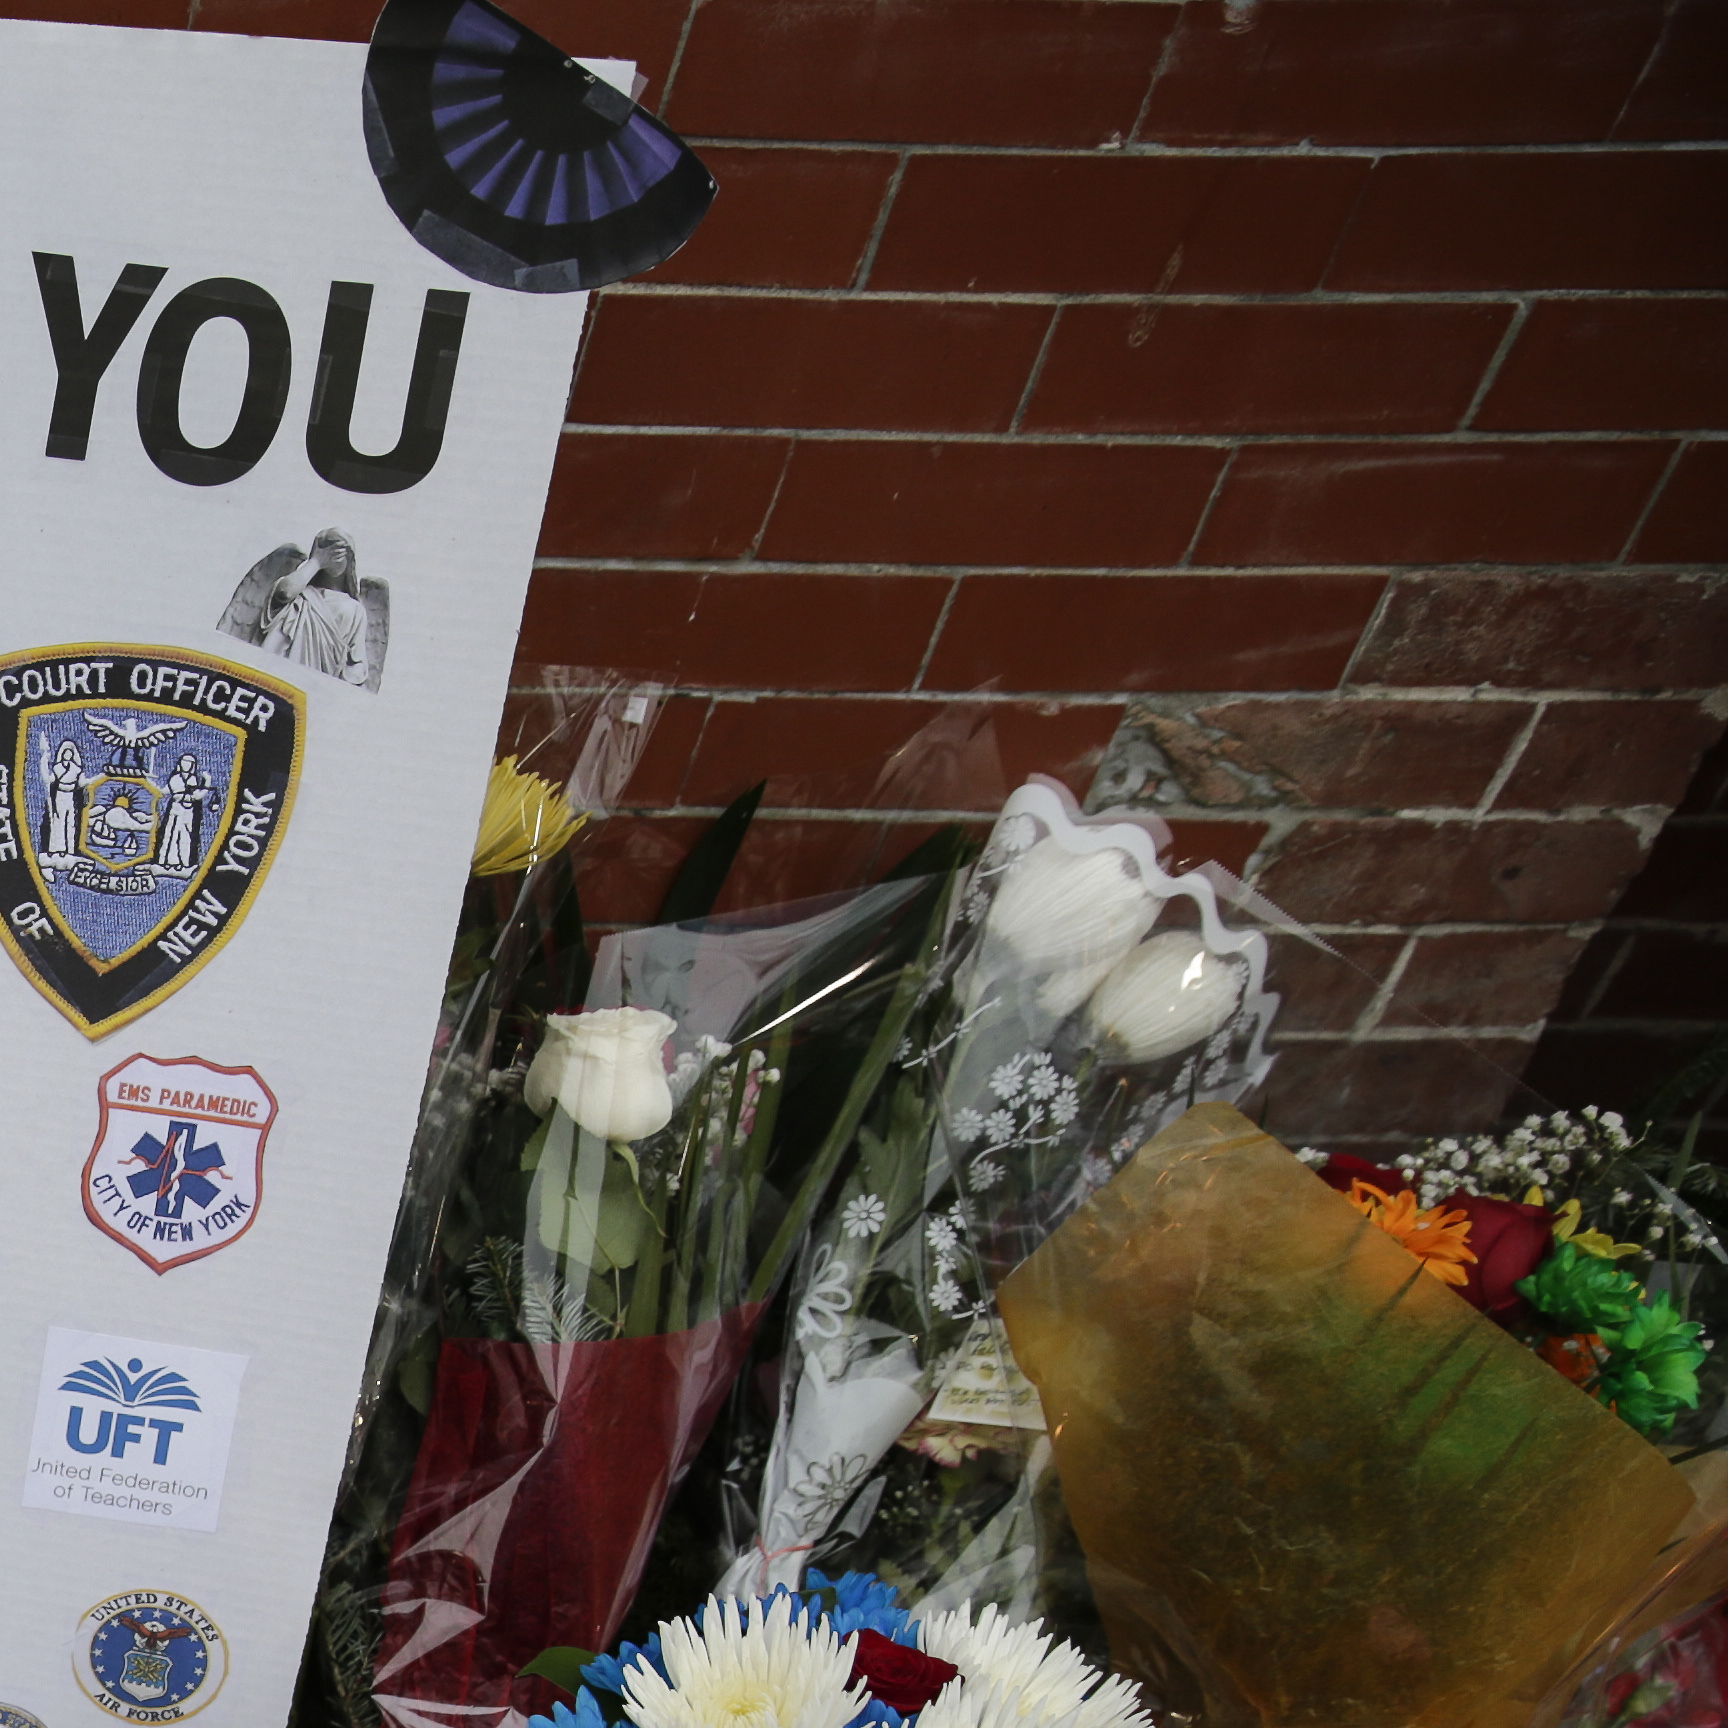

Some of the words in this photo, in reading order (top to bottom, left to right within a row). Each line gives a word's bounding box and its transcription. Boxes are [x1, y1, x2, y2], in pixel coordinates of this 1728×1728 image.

[31, 248, 470, 494] YOU
[130, 663, 275, 732] OFFICER
[11, 901, 53, 940] OF
[157, 889, 229, 964] NEW
[216, 788, 277, 876] YORK
[118, 1082, 152, 1102] EMS
[159, 1088, 258, 1118] PARAMEDIC
[93, 1174, 131, 1217] CITY
[127, 1211, 154, 1234] OF
[153, 1220, 193, 1242] NEW
[198, 1194, 252, 1236] YORK
[66, 1405, 184, 1466] UFT
[53, 1483, 73, 1498] of
[81, 1485, 173, 1516] Teachers
[99, 1467, 208, 1500] Federation
[90, 1593, 158, 1622] UNITED
[164, 1596, 219, 1642] STATES
[95, 1693, 120, 1713] AIR
[126, 1706, 184, 1722] FORCE
